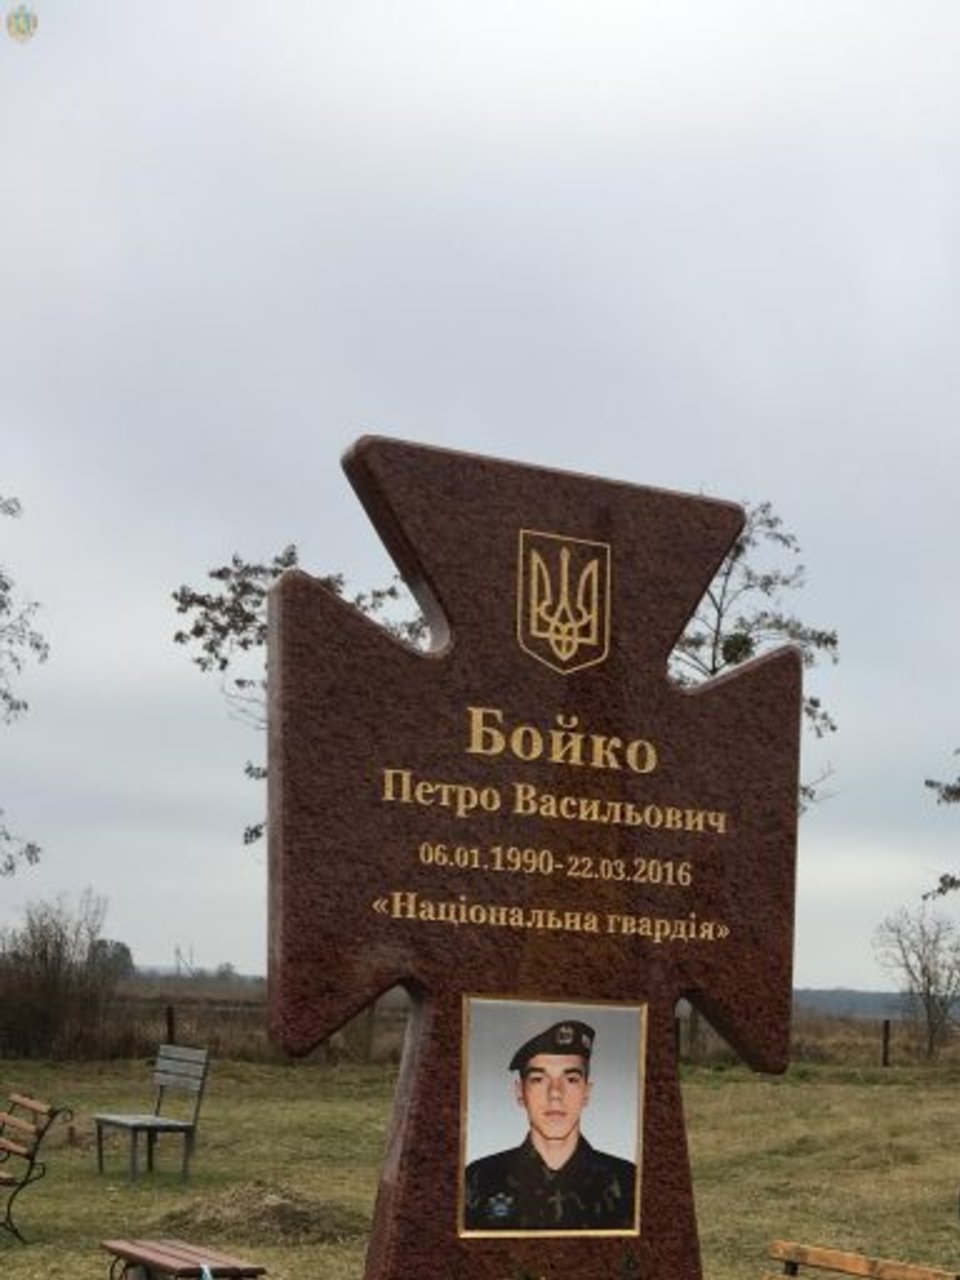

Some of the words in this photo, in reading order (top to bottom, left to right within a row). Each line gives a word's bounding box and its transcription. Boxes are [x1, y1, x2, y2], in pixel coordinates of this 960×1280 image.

[467, 705, 658, 774] Бойко
[381, 769, 501, 819] Петро
[513, 782, 728, 834] Васильович
[371, 891, 600, 935] «Національна
[606, 911, 732, 945] гвардія»
